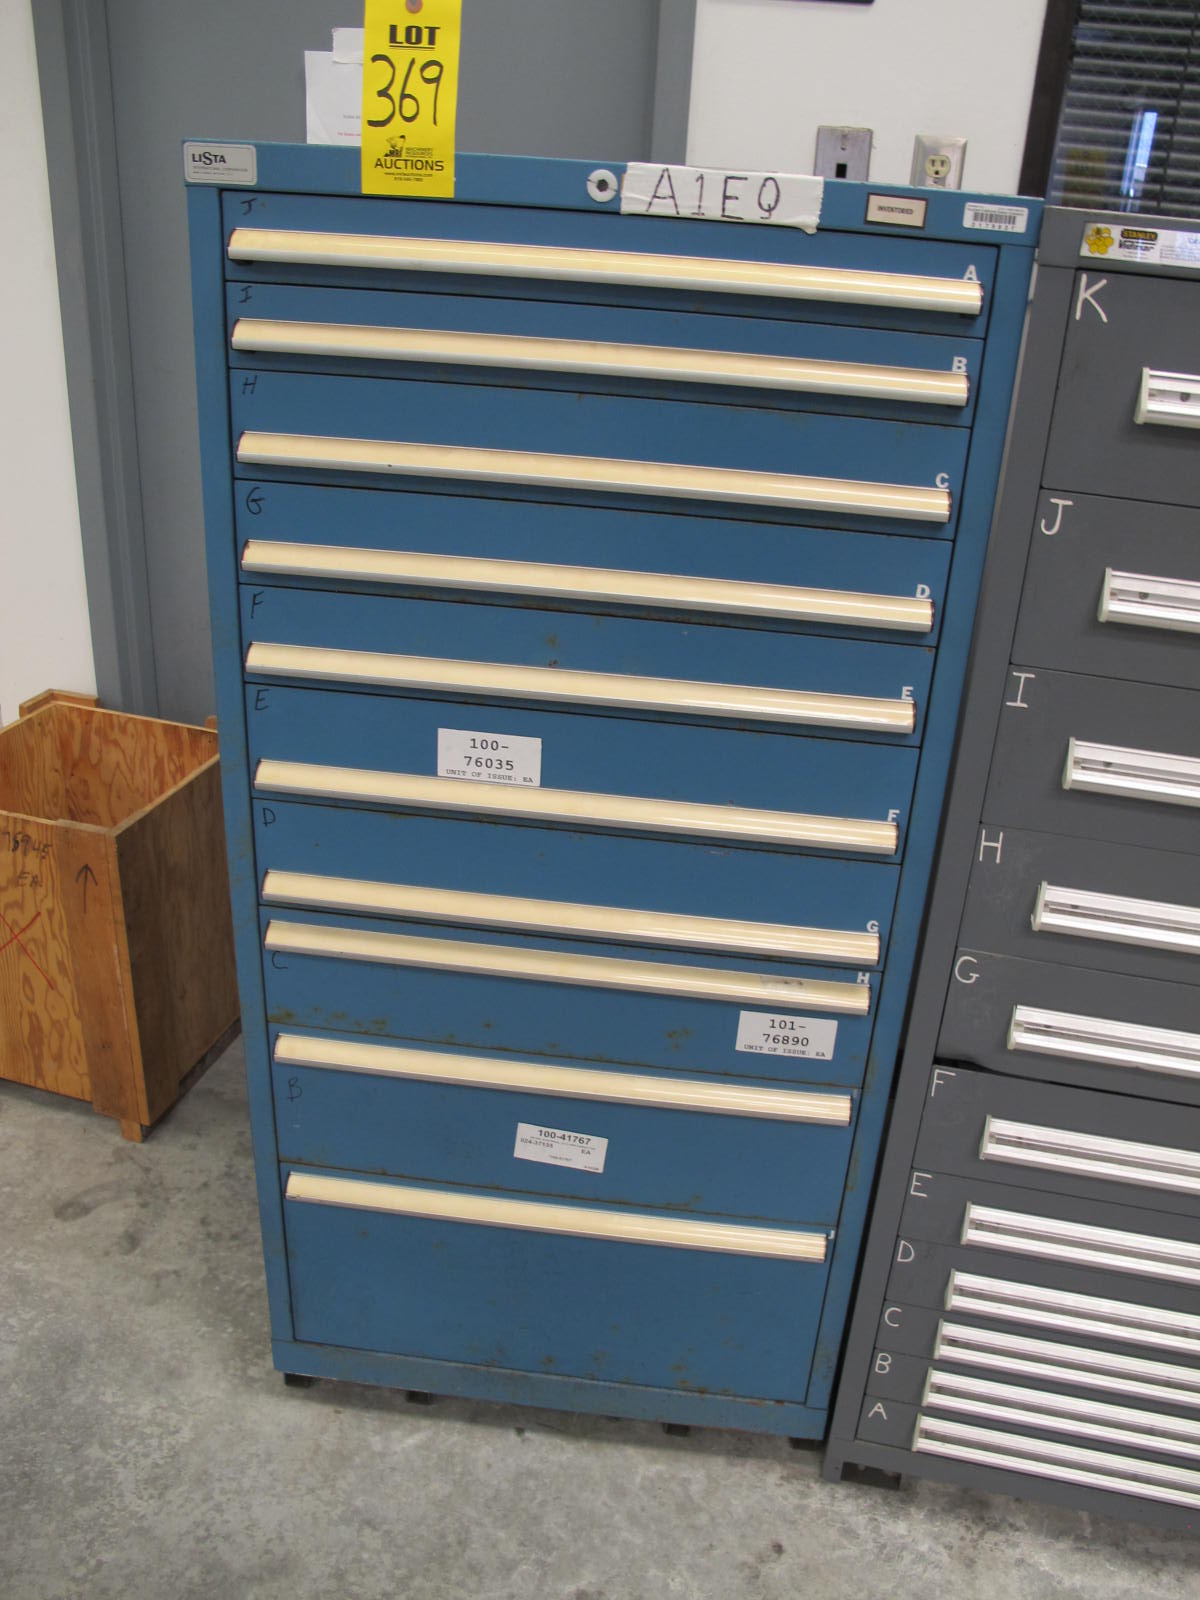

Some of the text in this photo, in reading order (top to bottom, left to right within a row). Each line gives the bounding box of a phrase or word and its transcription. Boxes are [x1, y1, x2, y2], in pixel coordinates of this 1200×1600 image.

[389, 25, 440, 46] LOT
[367, 54, 444, 127] 369
[192, 151, 226, 166] LISTA
[374, 158, 445, 172] AUCTIONS
[1122, 229, 1156, 240] STANLEY
[963, 265, 978, 281] A
[1075, 273, 1108, 323] K
[952, 357, 968, 372] B
[242, 375, 258, 394] H
[935, 472, 949, 489] C
[246, 487, 265, 515] G
[1040, 498, 1074, 535] J
[915, 584, 930, 599] D
[251, 591, 264, 619] F
[901, 686, 914, 701] E
[1005, 671, 1036, 708] I
[255, 689, 269, 711] E
[469, 738, 510, 752] 100-
[464, 755, 514, 771] 76035
[446, 769, 467, 777] UNIT
[262, 808, 276, 826] D
[887, 809, 900, 823] F
[979, 829, 1003, 864] H
[866, 920, 880, 933] G
[272, 951, 288, 970] C
[954, 956, 980, 983] G
[857, 972, 870, 984] H
[769, 1019, 807, 1031] 101-
[744, 1044, 763, 1052] UNIT
[762, 1033, 809, 1047] 76890
[287, 1077, 302, 1101] B
[931, 1069, 957, 1097] F
[537, 1129, 592, 1146] 100-41767
[910, 1171, 933, 1197] E
[897, 1239, 915, 1262] D
[884, 1307, 902, 1327] C
[875, 1353, 892, 1374] B
[868, 1402, 888, 1420] A
